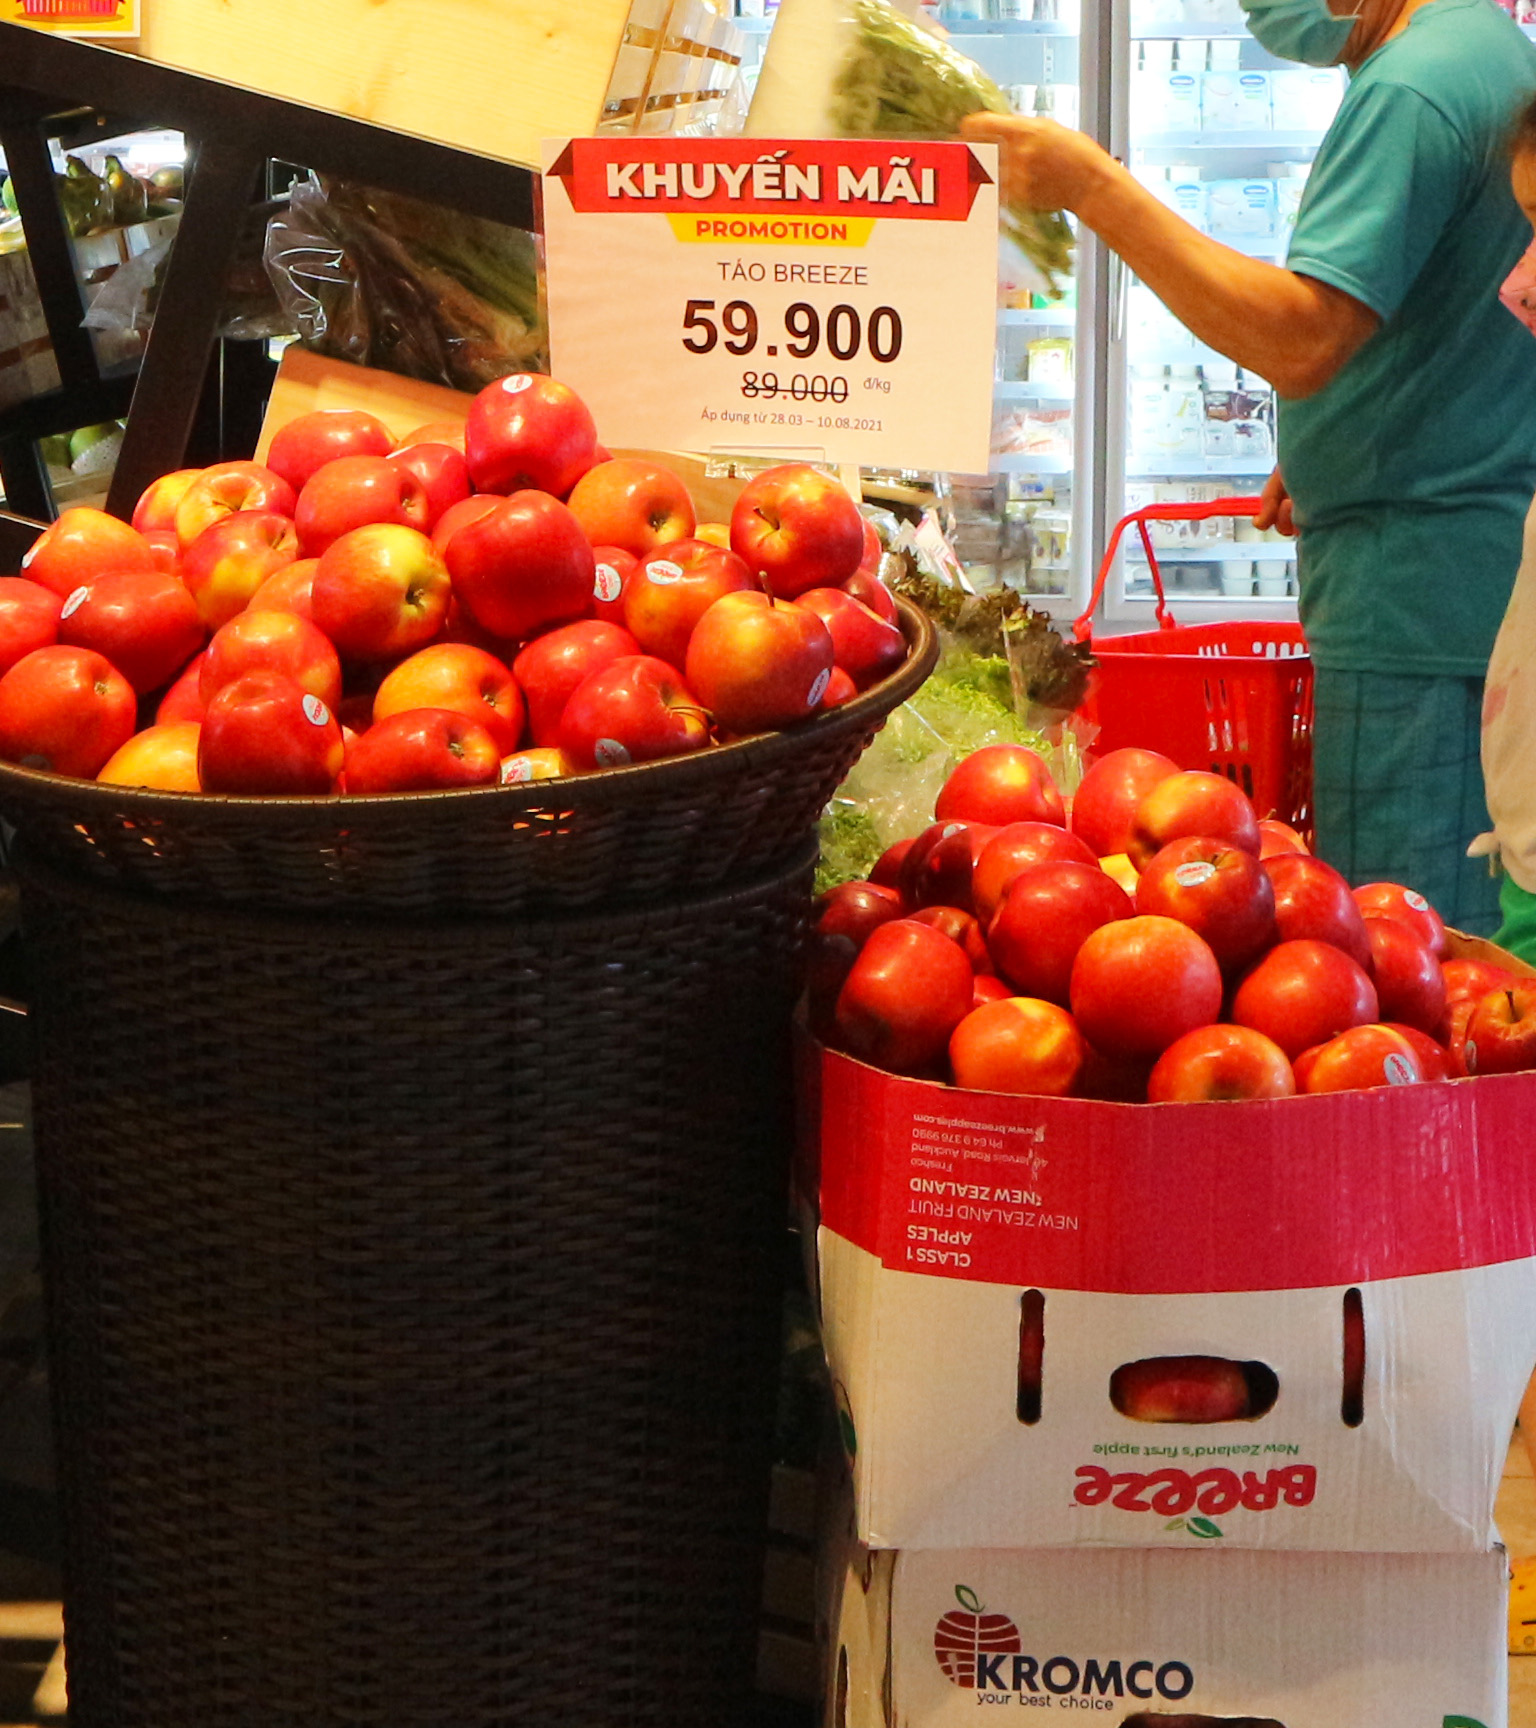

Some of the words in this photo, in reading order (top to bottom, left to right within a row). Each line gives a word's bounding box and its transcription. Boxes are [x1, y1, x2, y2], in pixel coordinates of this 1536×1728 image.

[605, 149, 822, 202] KHUYẾN
[837, 156, 937, 206] MÃI
[695, 219, 848, 241] PROMOTION
[718, 258, 766, 283] TÁO
[774, 263, 869, 286] BREEZE
[681, 299, 904, 363] 59.900
[740, 370, 850, 404] 89.000
[863, 376, 892, 394] đ/kg
[700, 409, 718, 424] Áp
[719, 410, 750, 426] dụng
[751, 410, 768, 424] từ
[769, 412, 803, 426] 28.03
[817, 414, 884, 432] 10.08.2021
[909, 1177, 991, 1202] ZEALAND
[993, 1187, 1037, 1207] NEW
[907, 1198, 954, 1219] FRUIT
[956, 1205, 1037, 1227] ZEALAND
[1037, 1212, 1080, 1231] NEW
[906, 1223, 973, 1246] APPLES
[906, 1245, 914, 1262] 1
[915, 1246, 972, 1268] CLASS
[1092, 1442, 1140, 1457] apple
[1144, 1443, 1180, 1459] first
[1182, 1443, 1261, 1458] Zealand's
[1263, 1442, 1300, 1457] New
[975, 1652, 1194, 1701] KROMCO
[976, 1691, 1012, 1707] your
[1018, 1691, 1052, 1708] best
[1058, 1695, 1114, 1711] choice
